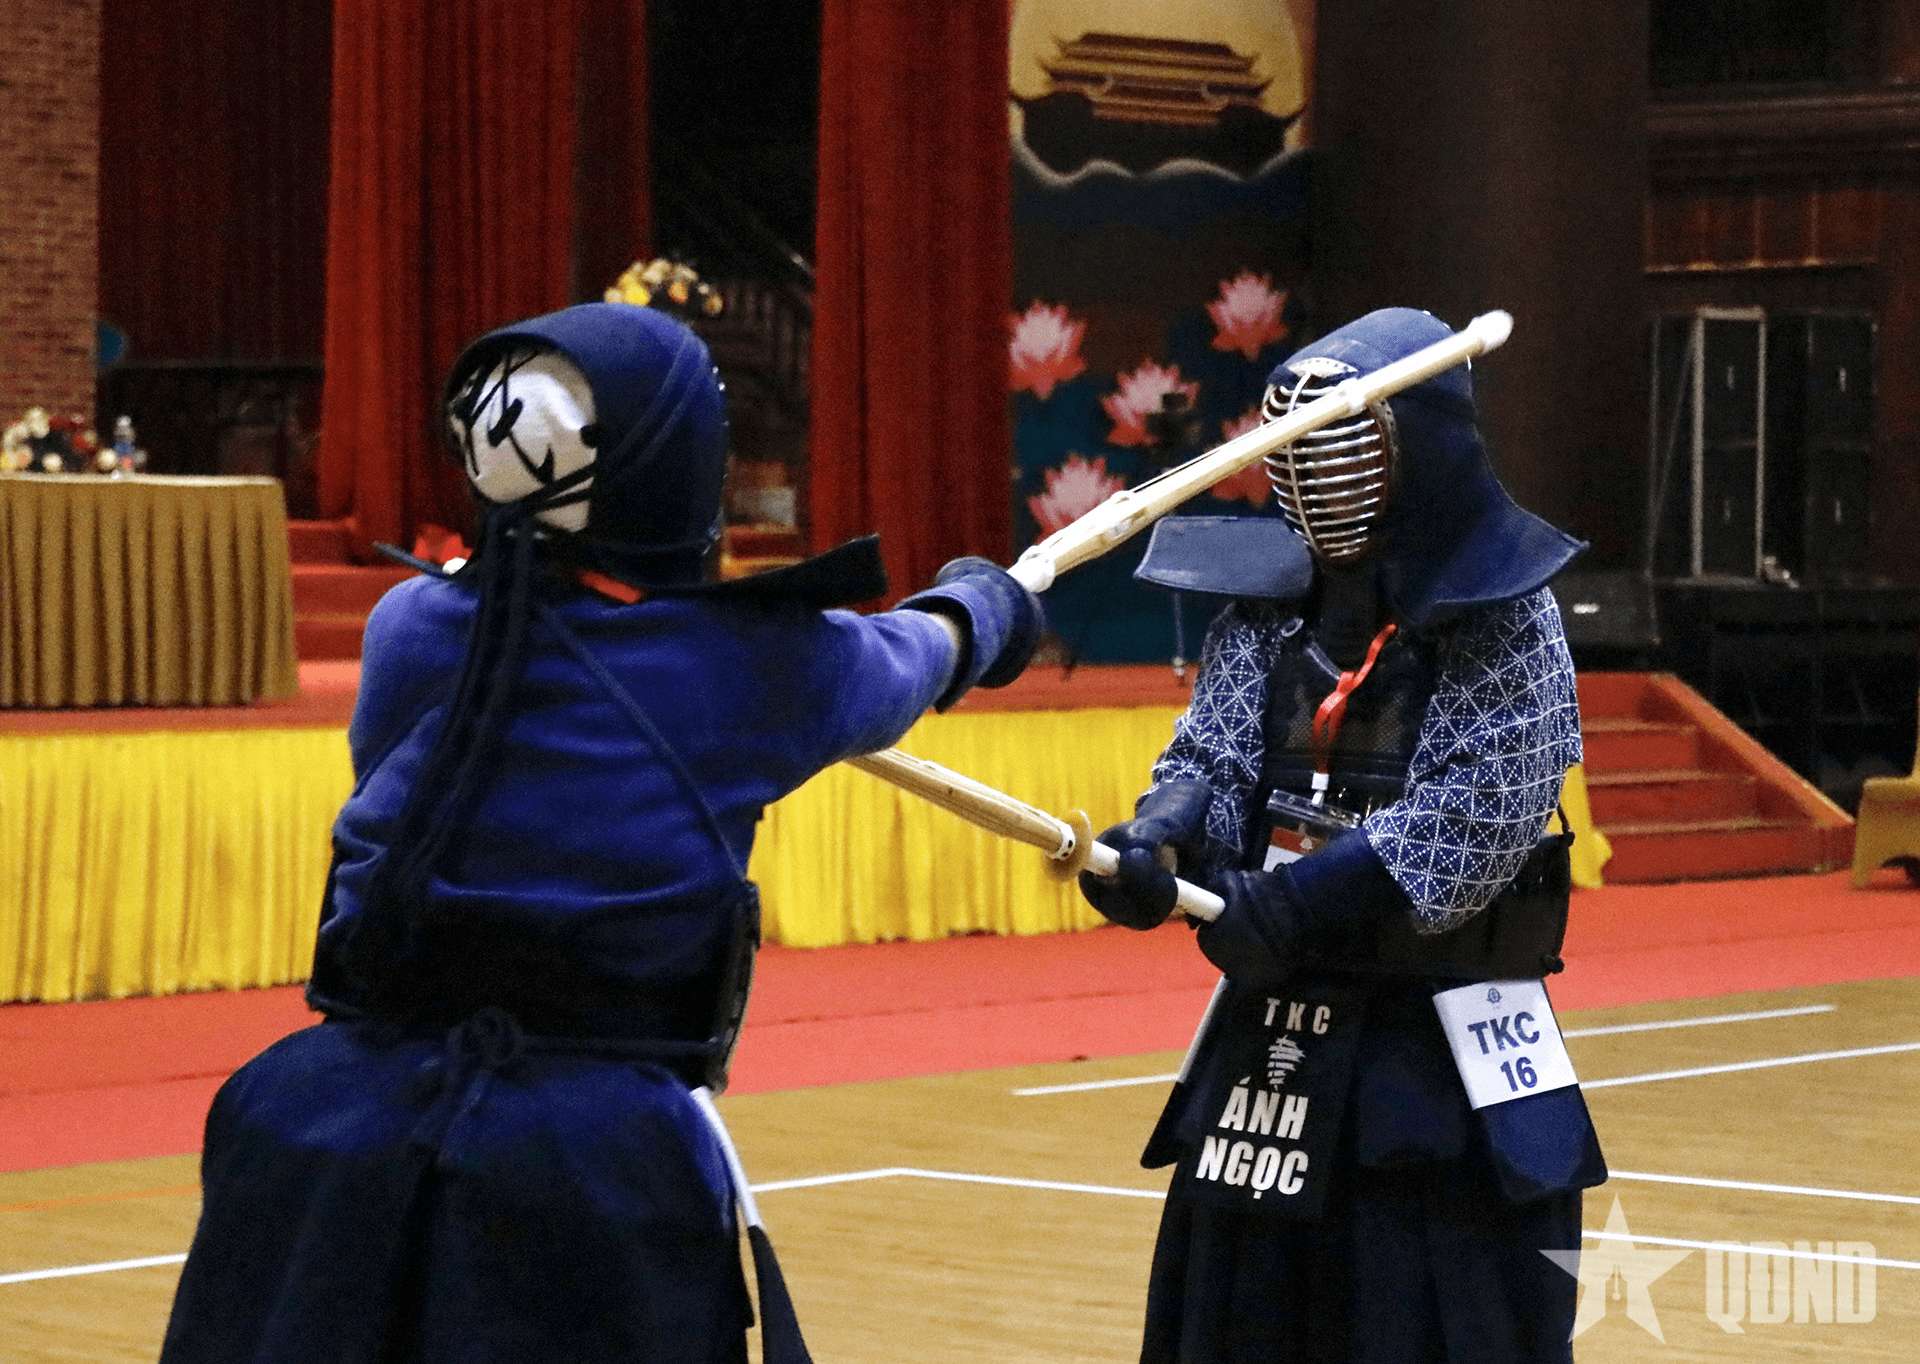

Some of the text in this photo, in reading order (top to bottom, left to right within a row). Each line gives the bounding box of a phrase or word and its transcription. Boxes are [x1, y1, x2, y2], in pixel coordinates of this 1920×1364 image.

[1264, 998, 1331, 1034] TKC
[1467, 1011, 1540, 1055] TKC
[1500, 1056, 1538, 1092] 16
[1218, 1076, 1309, 1140] ÁNH
[1195, 1135, 1309, 1199] NGỌC
